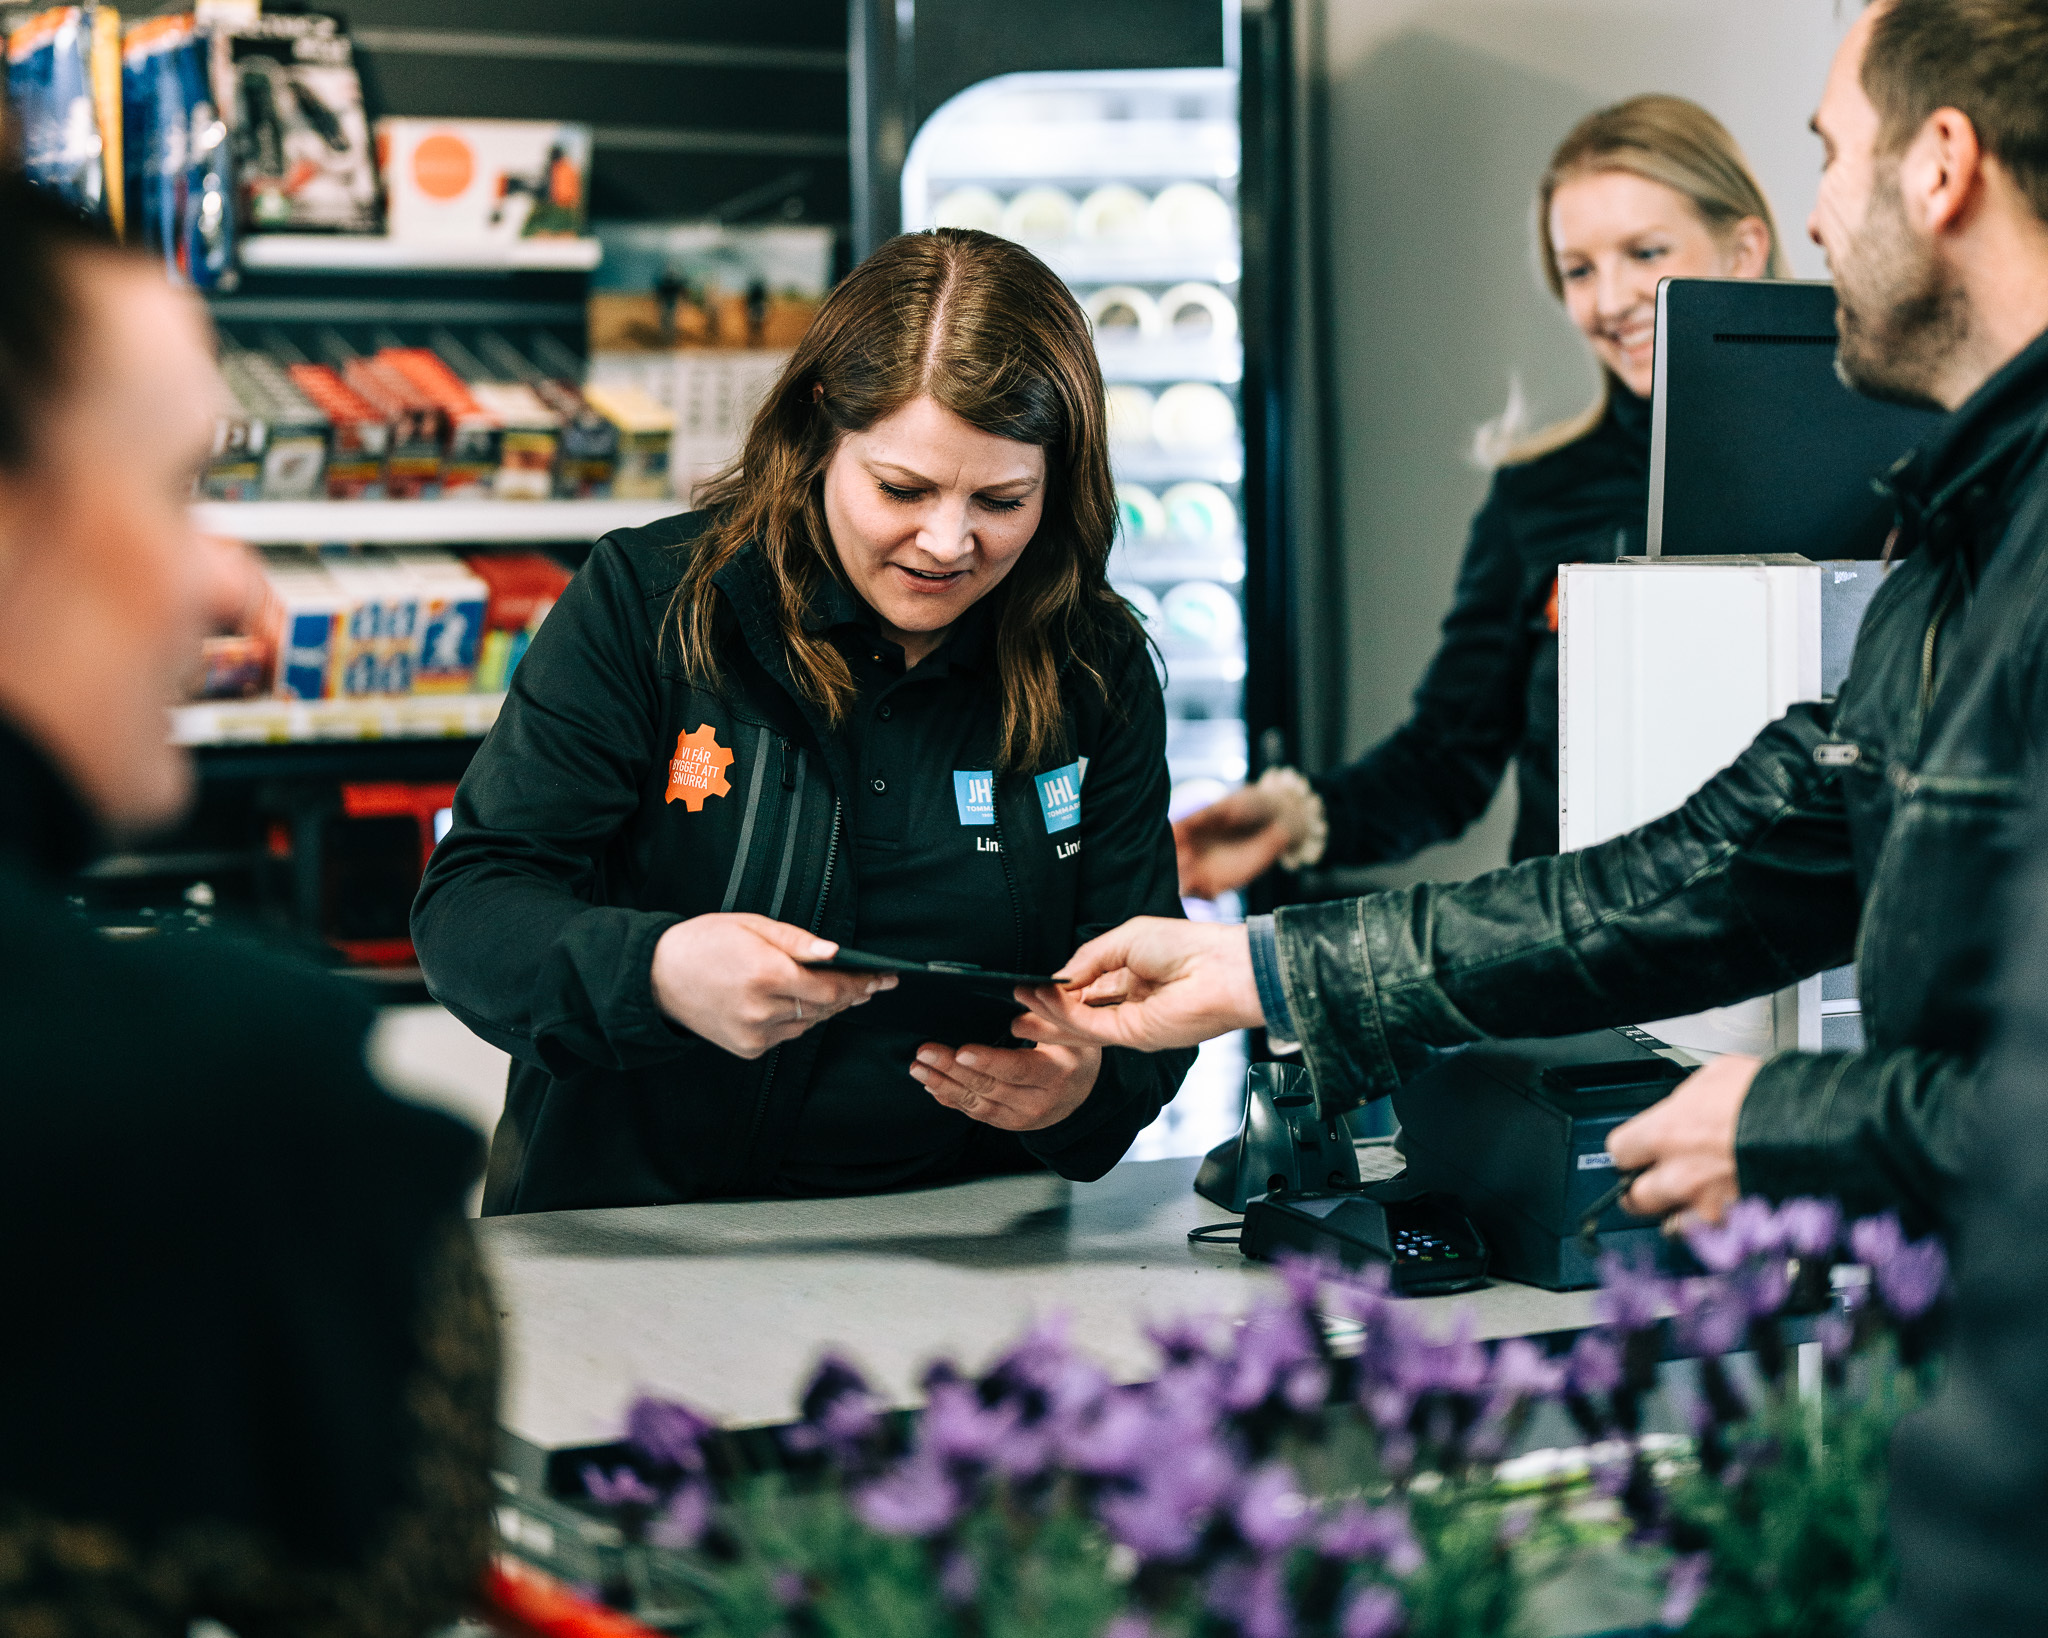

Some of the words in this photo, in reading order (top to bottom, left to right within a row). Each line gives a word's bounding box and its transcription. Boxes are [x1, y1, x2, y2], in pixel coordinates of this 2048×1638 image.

[682, 747, 690, 759] VI
[692, 747, 711, 763] FÅR
[672, 759, 701, 774] BYGGET
[701, 765, 719, 778] ATT
[673, 772, 707, 789] SNURRA
[968, 778, 993, 803] JH
[1044, 776, 1079, 808] JHL
[977, 837, 1002, 852] Lin
